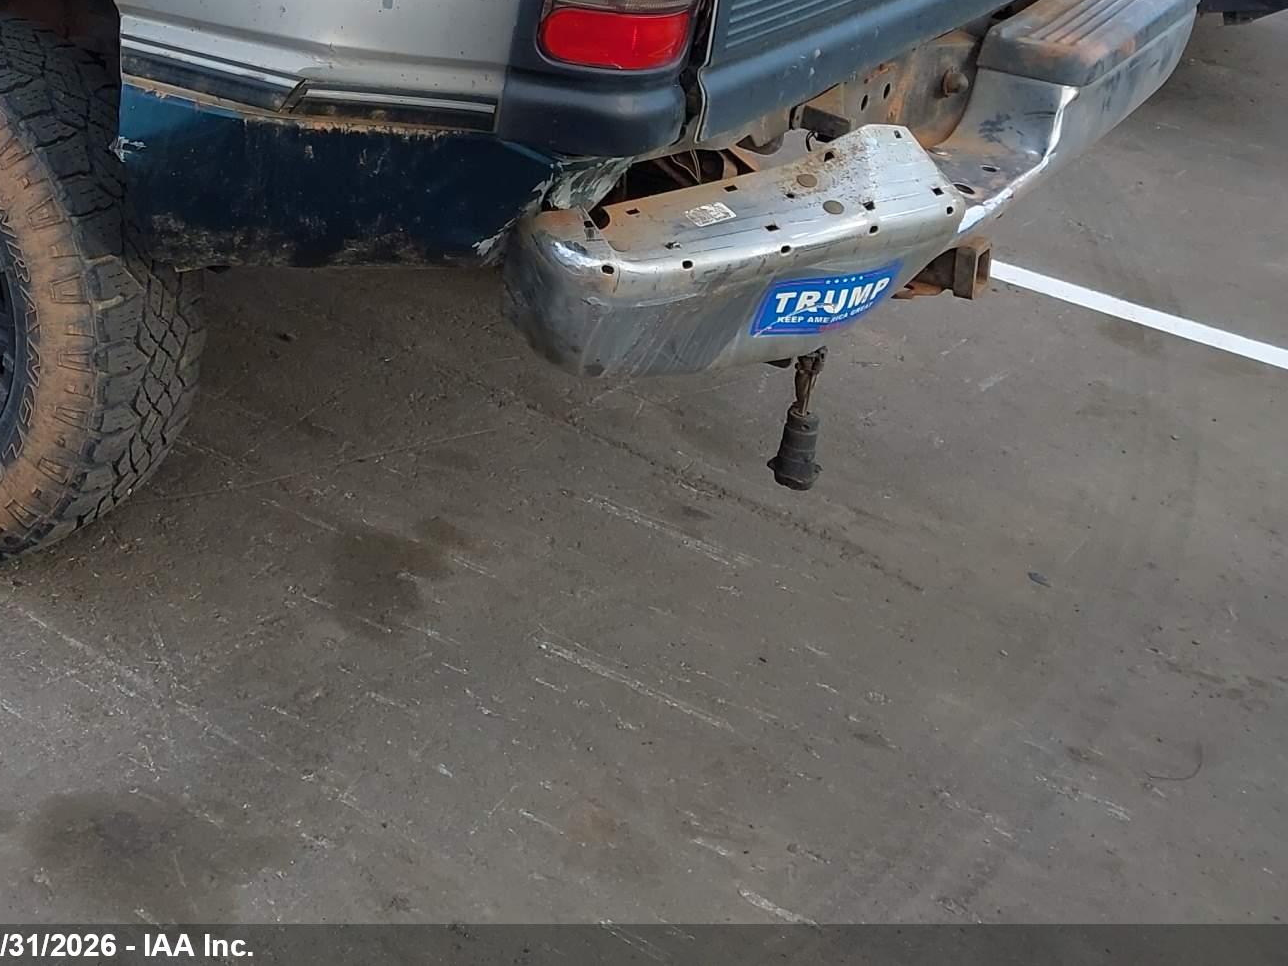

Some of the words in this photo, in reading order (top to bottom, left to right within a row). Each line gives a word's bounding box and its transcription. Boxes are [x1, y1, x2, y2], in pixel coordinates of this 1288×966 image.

[775, 277, 891, 314] TRUMP
[776, 316, 805, 324] KEEP
[807, 312, 848, 324] AMERICA
